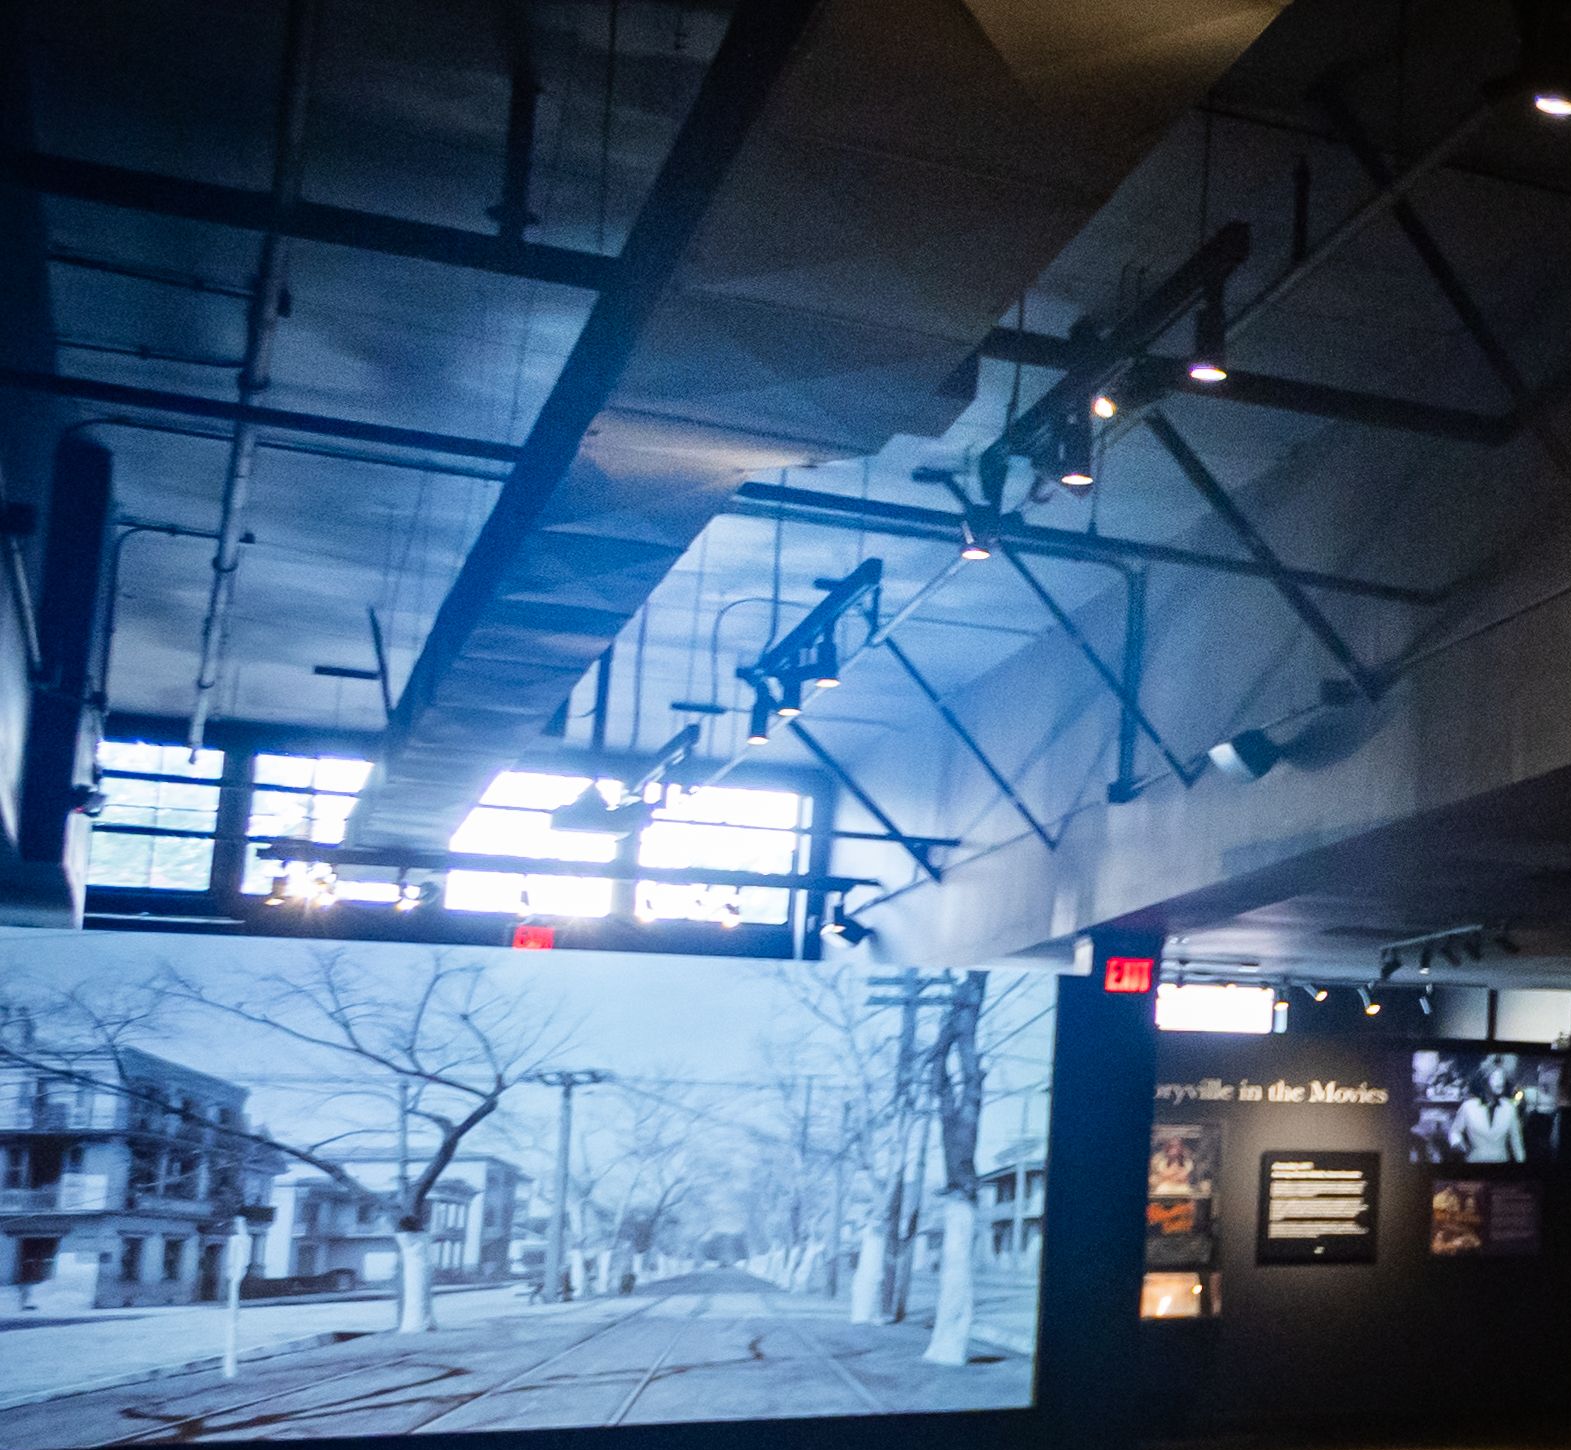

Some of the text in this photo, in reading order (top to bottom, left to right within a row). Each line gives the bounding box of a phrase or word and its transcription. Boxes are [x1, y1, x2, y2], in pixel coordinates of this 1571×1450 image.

[1238, 1079, 1263, 1101] in
[1267, 1079, 1304, 1103] the
[1308, 1080, 1389, 1105] Movies
